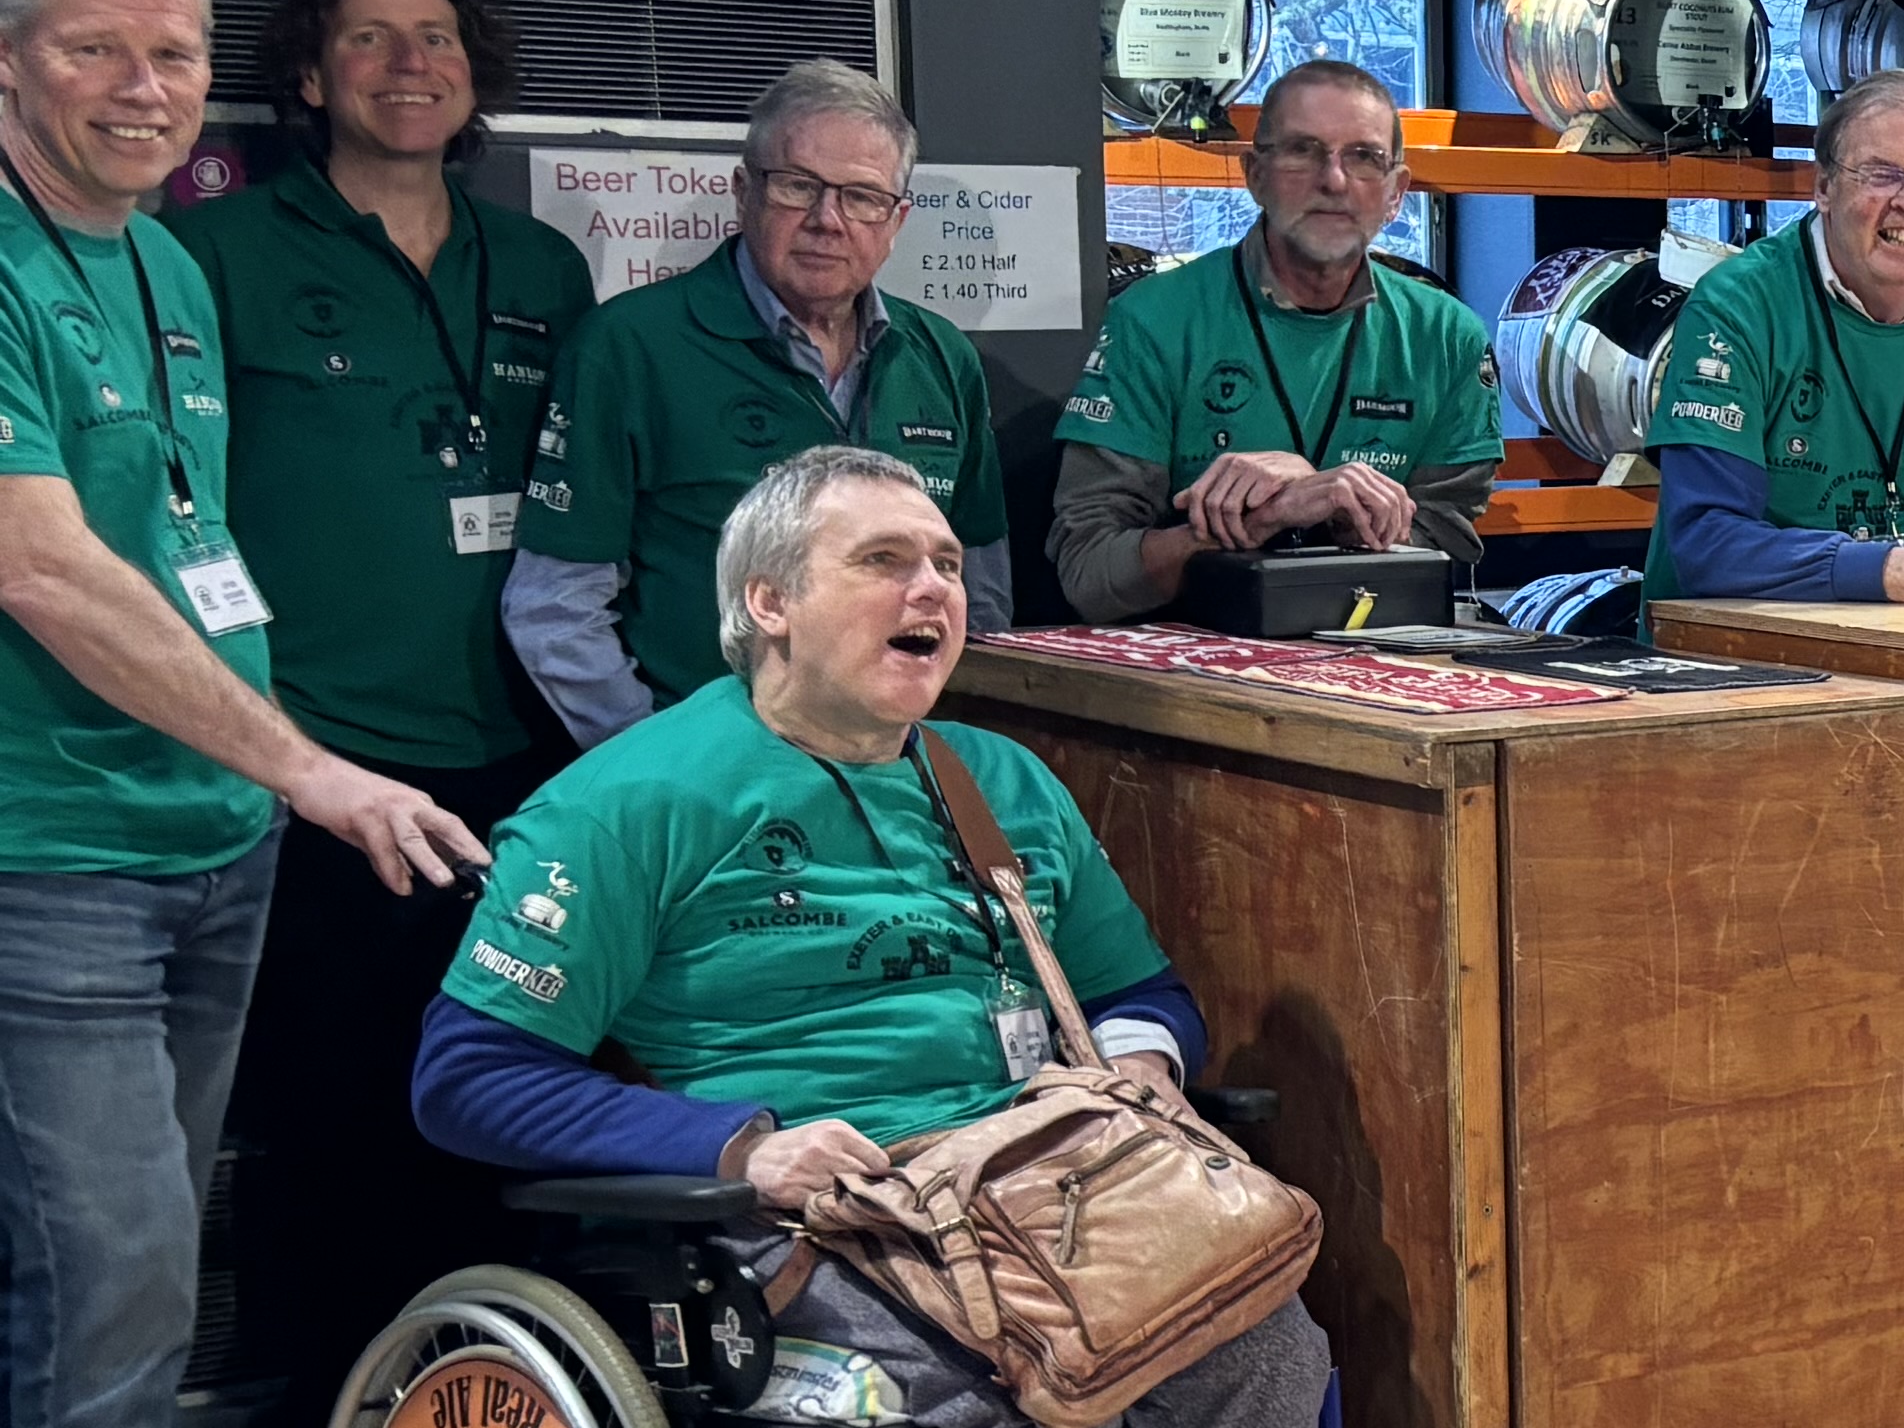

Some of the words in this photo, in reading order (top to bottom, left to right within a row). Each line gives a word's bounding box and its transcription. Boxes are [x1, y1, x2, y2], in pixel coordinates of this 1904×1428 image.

[556, 162, 638, 193] Beer
[647, 165, 732, 196] Toke
[956, 190, 970, 209] &
[977, 190, 1032, 209] Cider
[587, 209, 740, 240] Available
[943, 221, 994, 240] Price
[922, 254, 932, 270] £
[938, 254, 976, 271] 2.10
[982, 254, 1016, 270] Half
[924, 283, 934, 299] £
[941, 283, 978, 300] 1.40
[984, 283, 1027, 299] Third
[1672, 401, 1743, 429] POWDERKEG
[728, 912, 848, 932] SALCOMBE
[847, 919, 891, 970] EXETER
[470, 939, 564, 999] POWDERKEG
